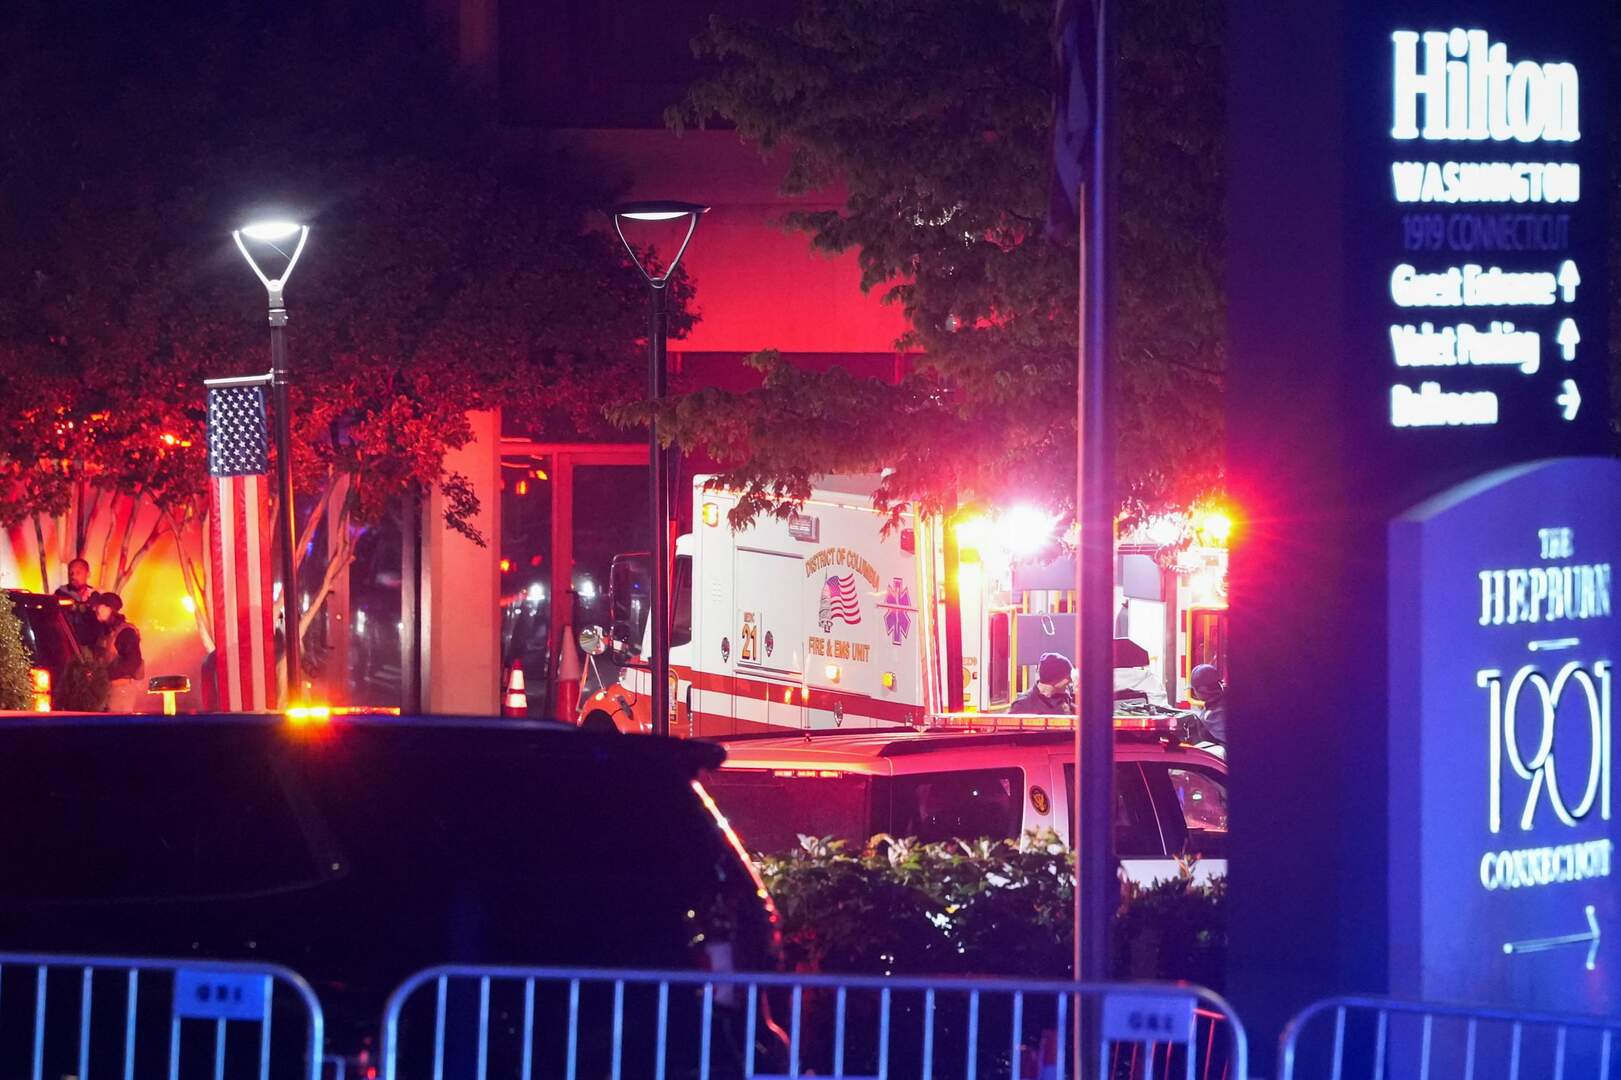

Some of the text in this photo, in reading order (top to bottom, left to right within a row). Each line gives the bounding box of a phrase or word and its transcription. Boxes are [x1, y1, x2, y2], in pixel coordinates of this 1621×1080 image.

[1391, 28, 1580, 142] Hilton
[1391, 162, 1580, 203] WASHINGTON
[1402, 213, 1570, 250] 1919 CONNECTICUT
[805, 547, 836, 577] DISTRICT
[836, 547, 846, 566] OF
[1538, 527, 1573, 559] THE
[1479, 564, 1611, 626] HEPBURN
[809, 636, 871, 663] FIRE & EMS UNIT
[1476, 660, 1611, 834] 1901
